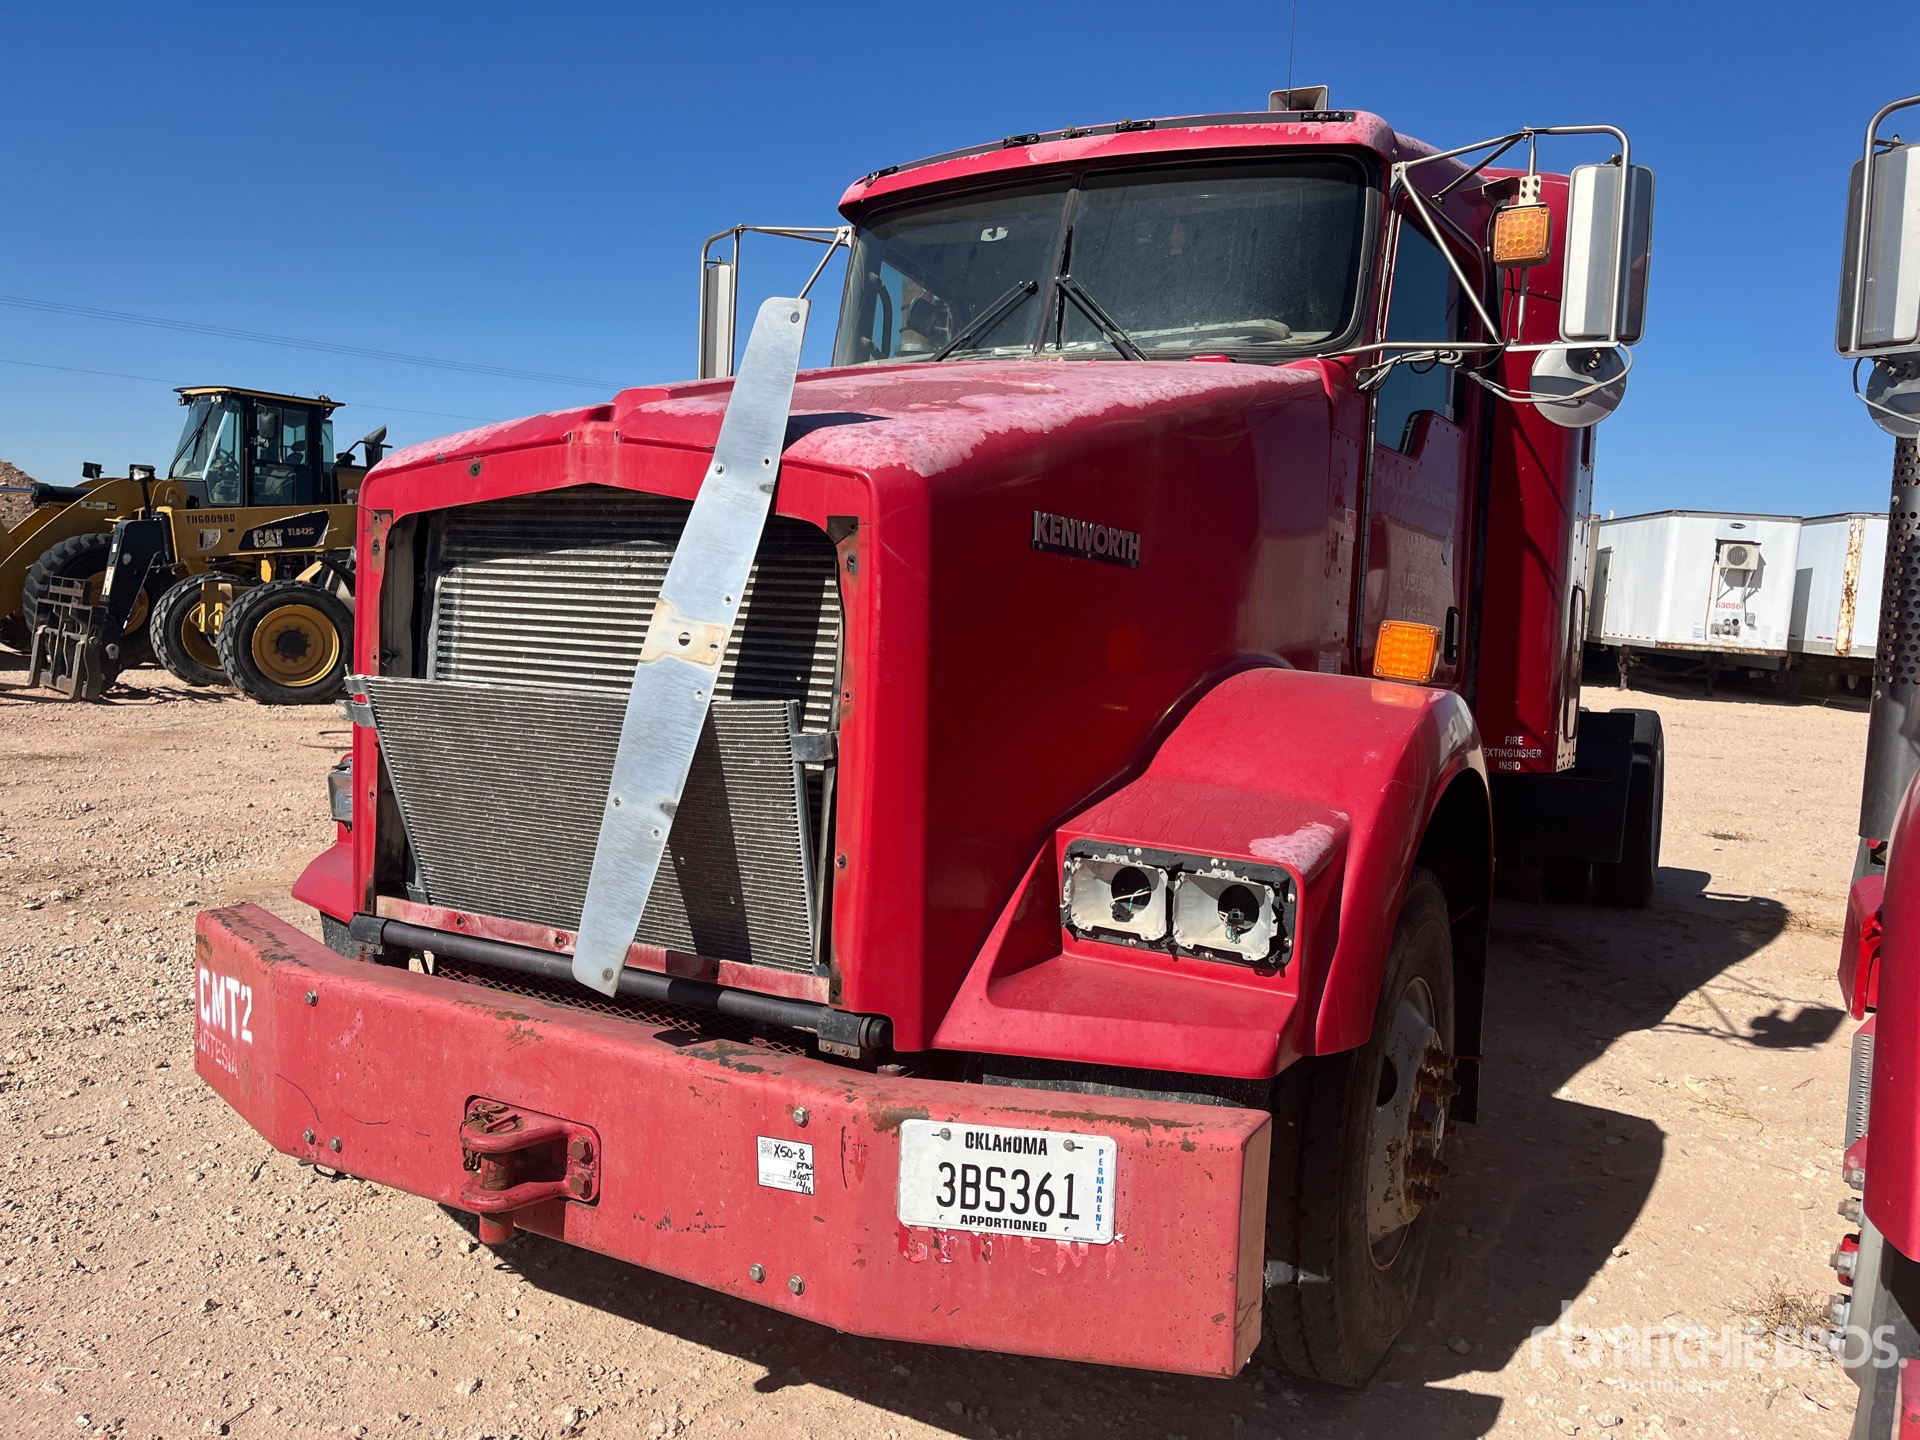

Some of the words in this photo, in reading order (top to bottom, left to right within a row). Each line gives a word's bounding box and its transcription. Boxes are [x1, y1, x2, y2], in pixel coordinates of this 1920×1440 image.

[253, 529, 283, 548] CAT
[1033, 510, 1141, 561] KENWORTH
[1504, 736, 1523, 745] FIRE
[1483, 748, 1542, 758] EXTINGUISHER
[1498, 761, 1521, 770] INSID
[199, 967, 253, 1045] CMT2
[773, 1143, 805, 1161] X50-8
[965, 1131, 1048, 1156] OKLAHOMA
[936, 1161, 1080, 1221] 3BS361
[1095, 1148, 1105, 1231] PERMANENT
[960, 1214, 1048, 1233] APPORTIONED
